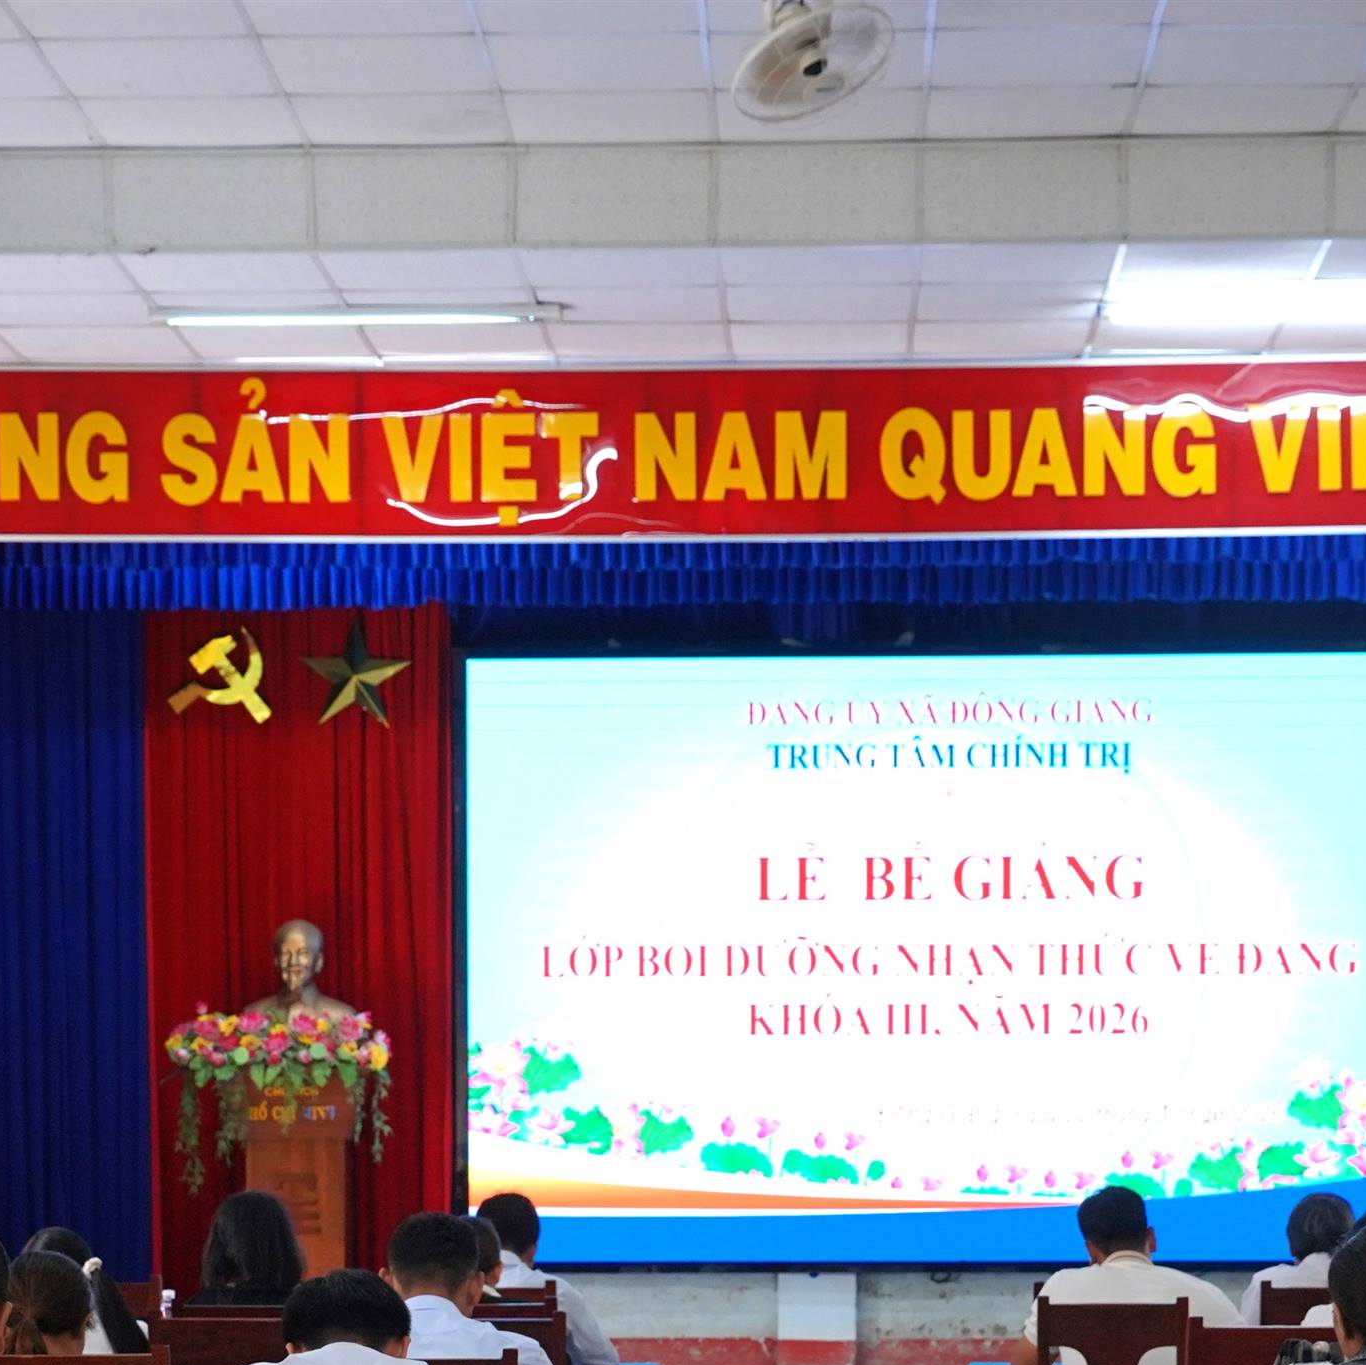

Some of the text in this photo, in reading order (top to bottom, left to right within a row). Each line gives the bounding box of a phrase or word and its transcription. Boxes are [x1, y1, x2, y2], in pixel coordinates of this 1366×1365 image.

[161, 379, 350, 506] SẢN
[383, 390, 598, 526] VIỆT
[635, 411, 847, 501] NAM
[880, 405, 1217, 503] QUANG
[1049, 699, 1154, 724] GIANG
[766, 732, 1134, 775] TRUNG TÂM CHÍNH TRỊ
[542, 935, 624, 978] LỚP
[749, 993, 873, 1036] KHÓA
[956, 994, 1052, 1036] NĂM
[1067, 1001, 1149, 1036] 2026
